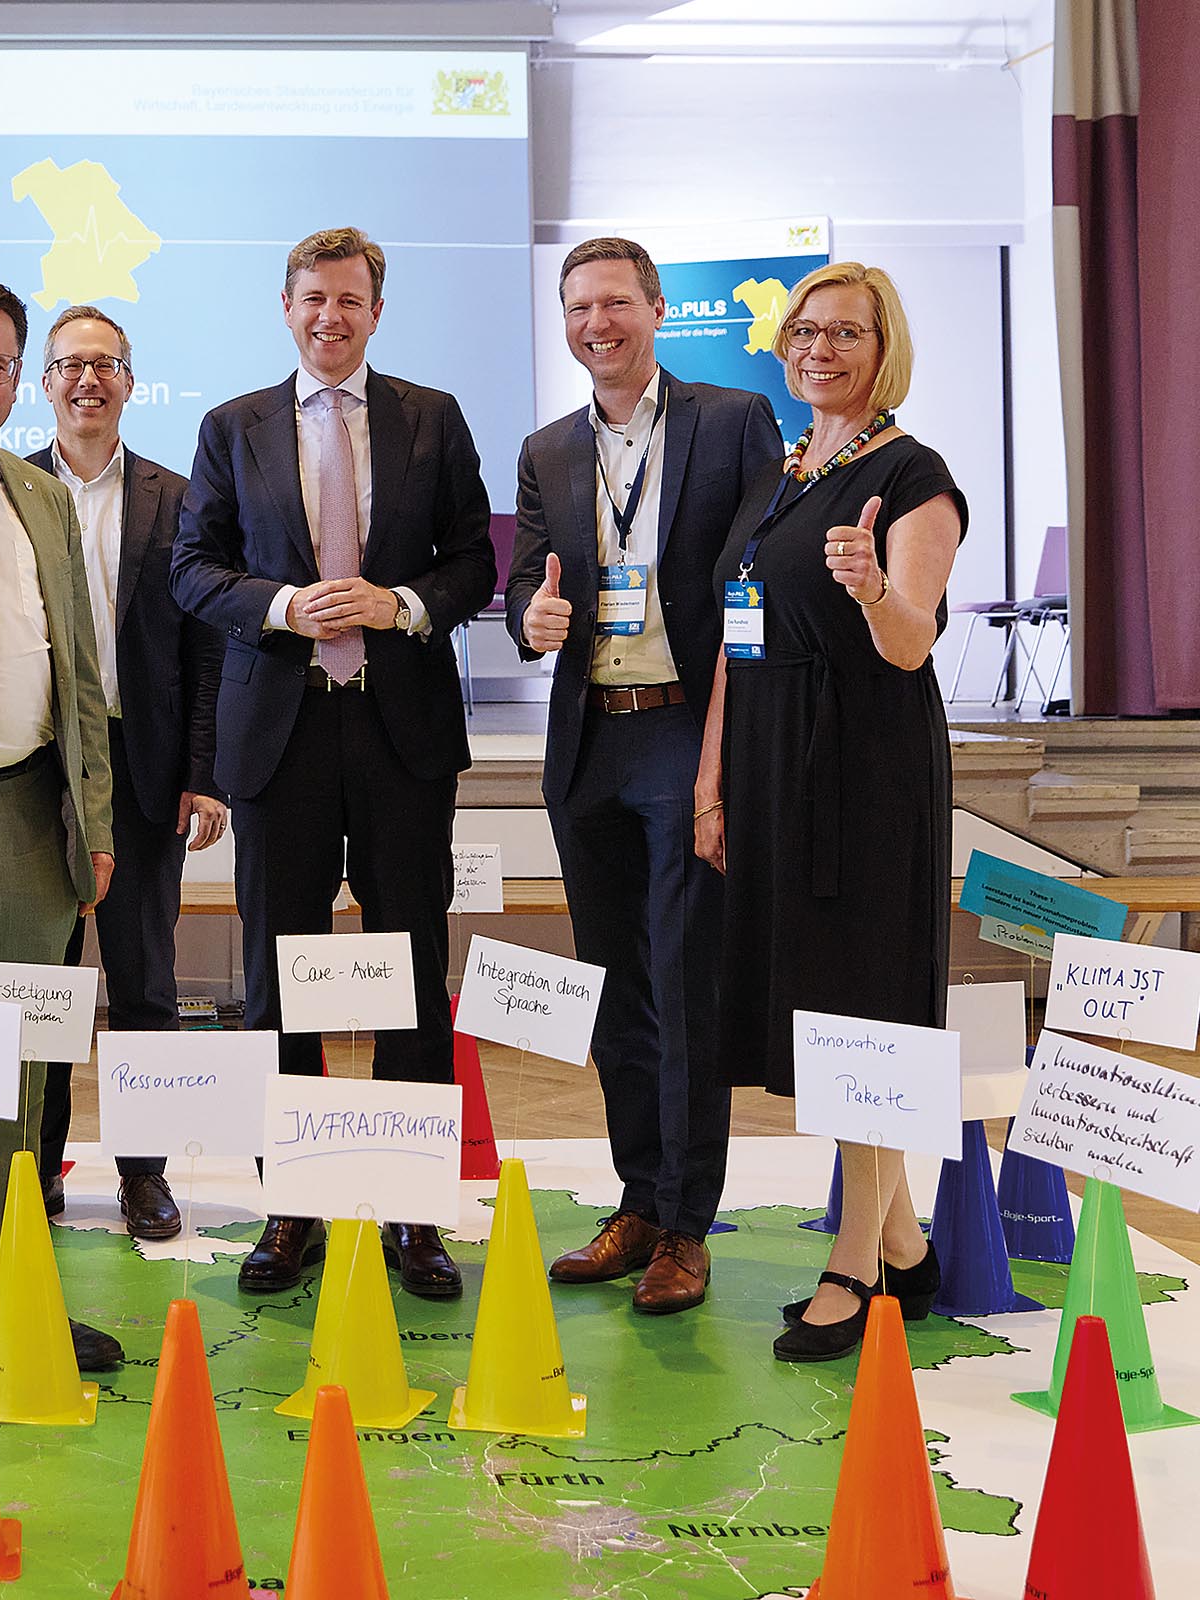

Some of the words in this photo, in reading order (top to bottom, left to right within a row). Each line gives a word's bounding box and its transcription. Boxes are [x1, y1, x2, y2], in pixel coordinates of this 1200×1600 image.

[981, 883, 1012, 899] Leerstand
[1022, 899, 1036, 908] kein
[1011, 903, 1022, 912] ein
[476, 951, 551, 992] Integration
[556, 974, 590, 1002] durch
[494, 987, 553, 1016] Sprache
[111, 1062, 217, 1093] Ressourcen
[835, 1073, 919, 1111] Pakete
[1127, 1108, 1163, 1124] und
[495, 1472, 604, 1486] Fürth
[667, 1522, 830, 1538] Nürnbe
